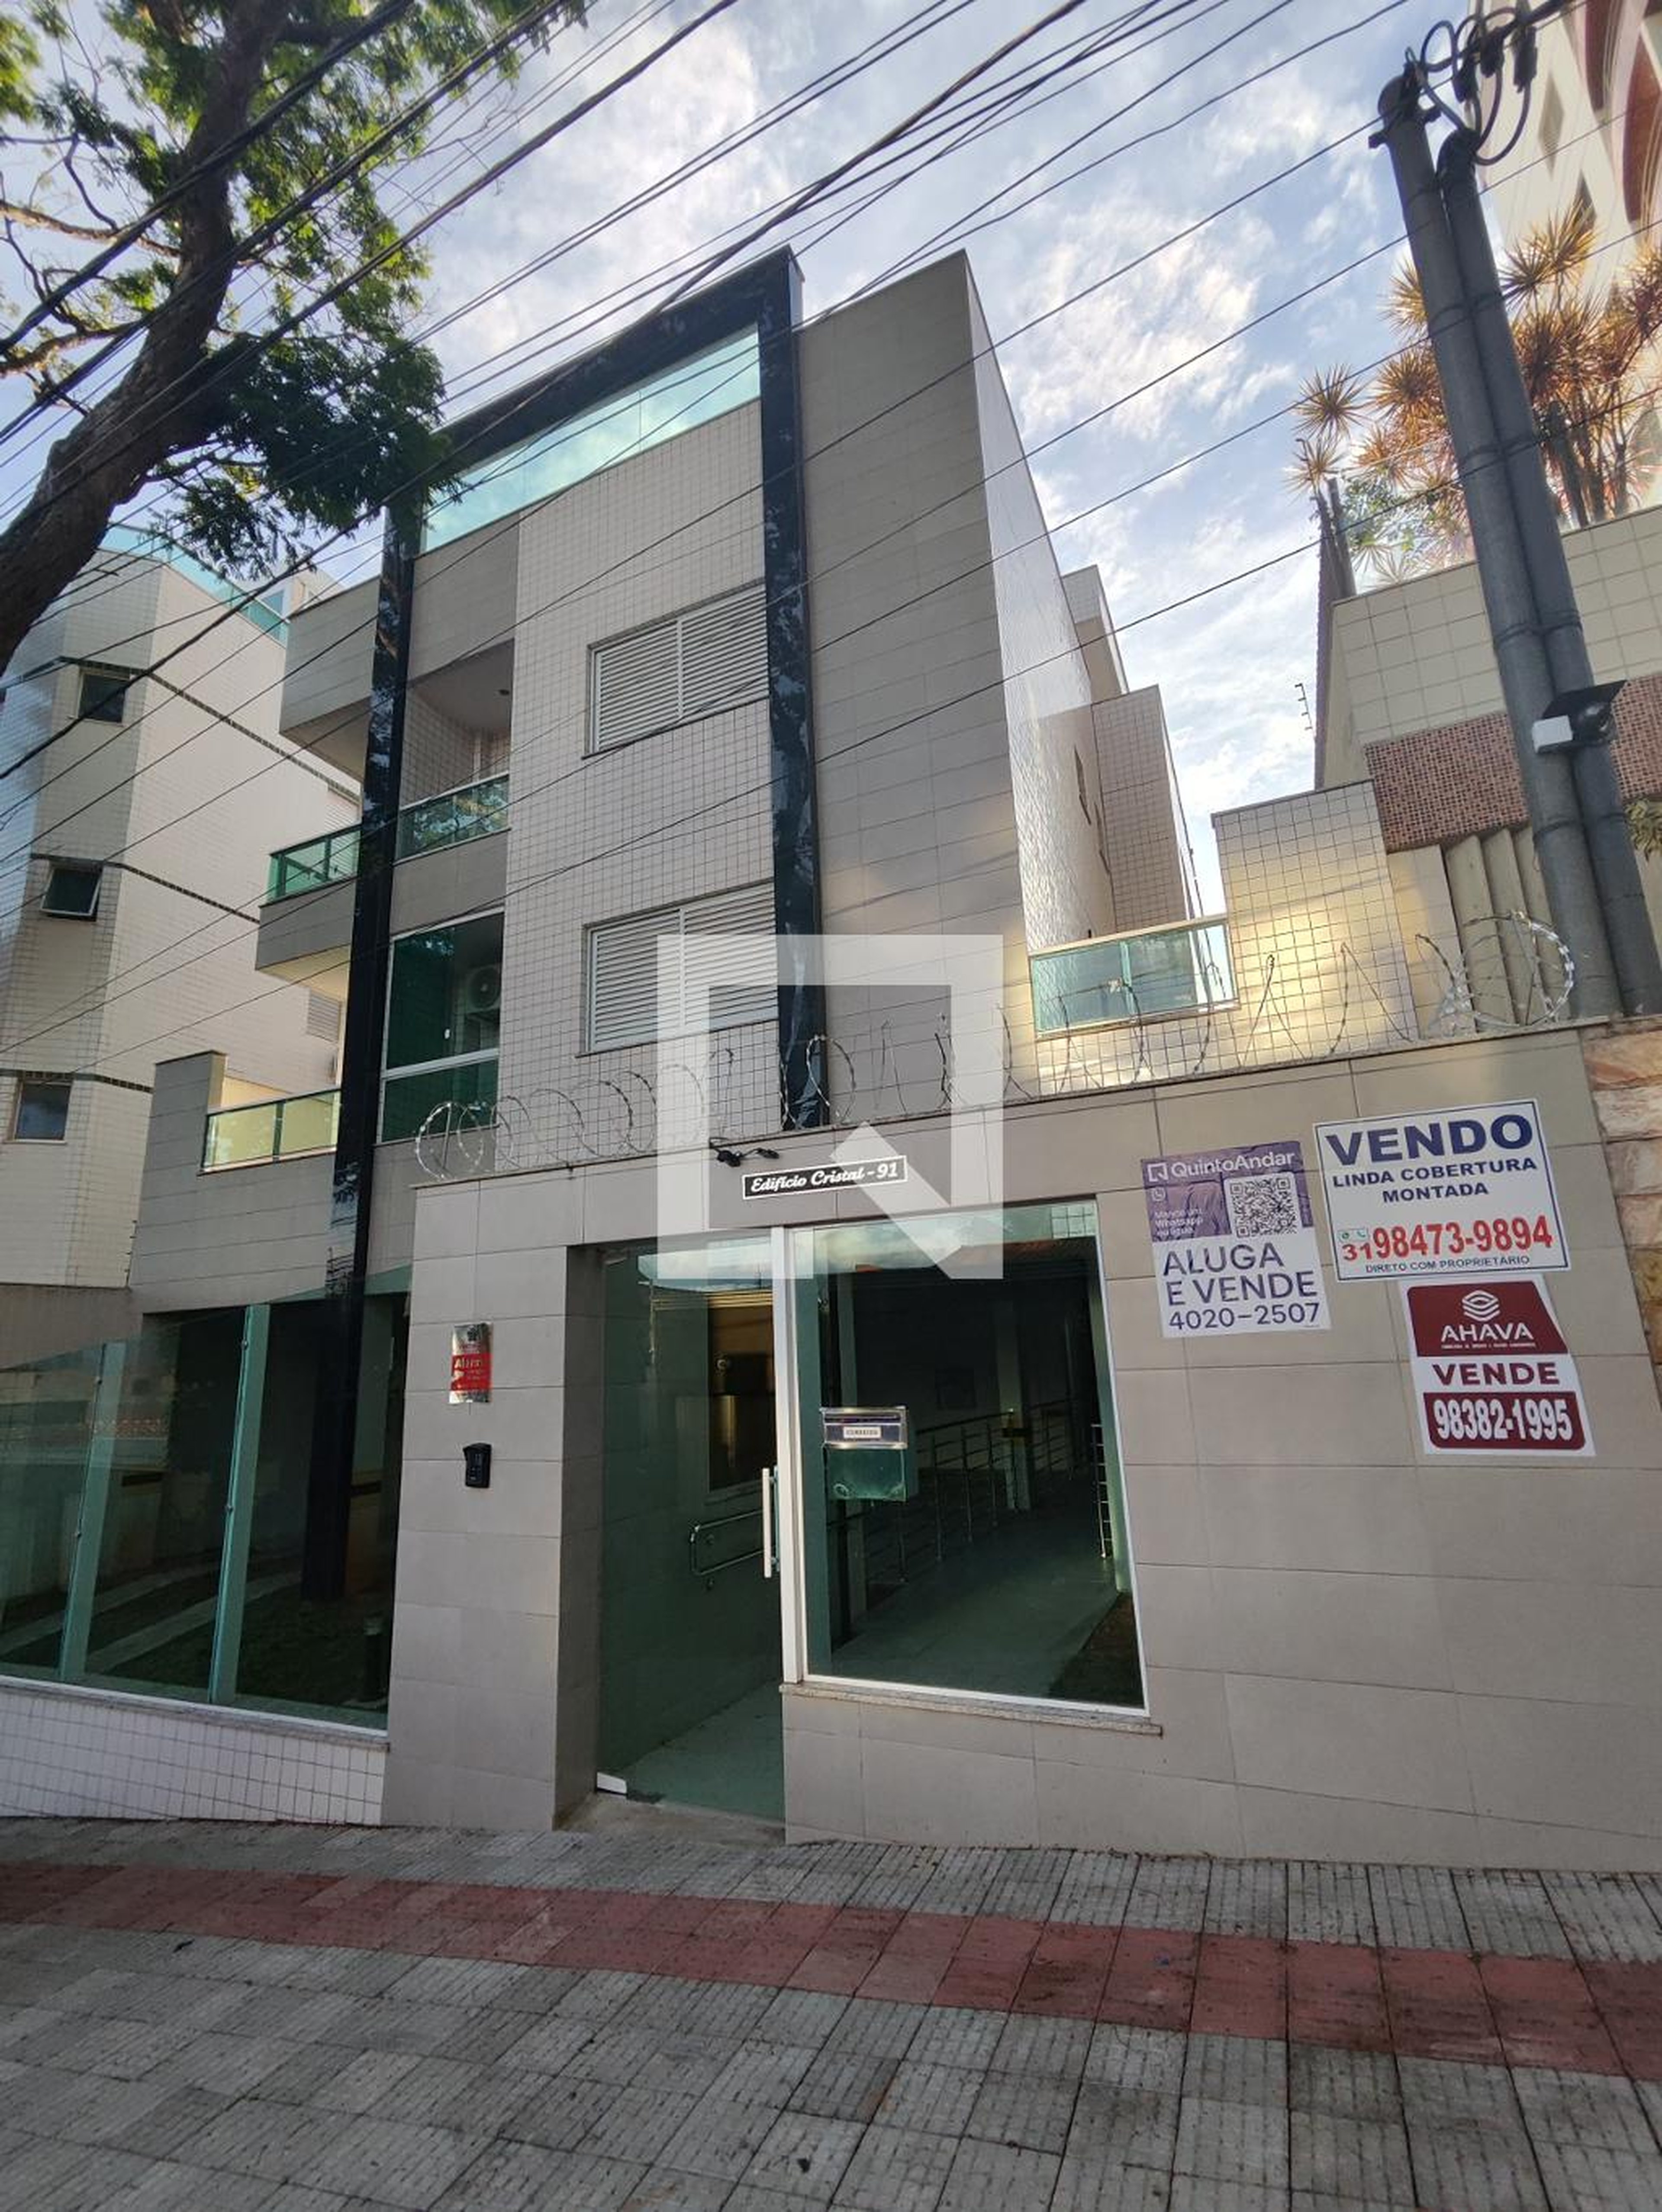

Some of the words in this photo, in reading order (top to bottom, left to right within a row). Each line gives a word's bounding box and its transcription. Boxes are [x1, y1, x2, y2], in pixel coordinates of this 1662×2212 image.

[1326, 1114, 1533, 1166] VENDO
[811, 1167, 865, 1186] Cristal
[876, 1162, 898, 1178] 91
[1170, 1151, 1295, 1178] QuintoAndar
[1333, 1171, 1394, 1188] LINDA
[1401, 1158, 1537, 1181] COBERTURA
[1382, 1182, 1488, 1203] MONTADA
[1163, 1242, 1284, 1276] ALUGA
[1366, 1262, 1408, 1273] DIRETO
[1410, 1261, 1436, 1271] COM
[1166, 1281, 1186, 1306] E
[1192, 1271, 1318, 1304] VENDE
[1169, 1302, 1320, 1330] 4020-2507
[1441, 1322, 1534, 1342] AHAVA
[1432, 1362, 1560, 1385] VENDE
[1433, 1398, 1573, 1440] 98382-1995
